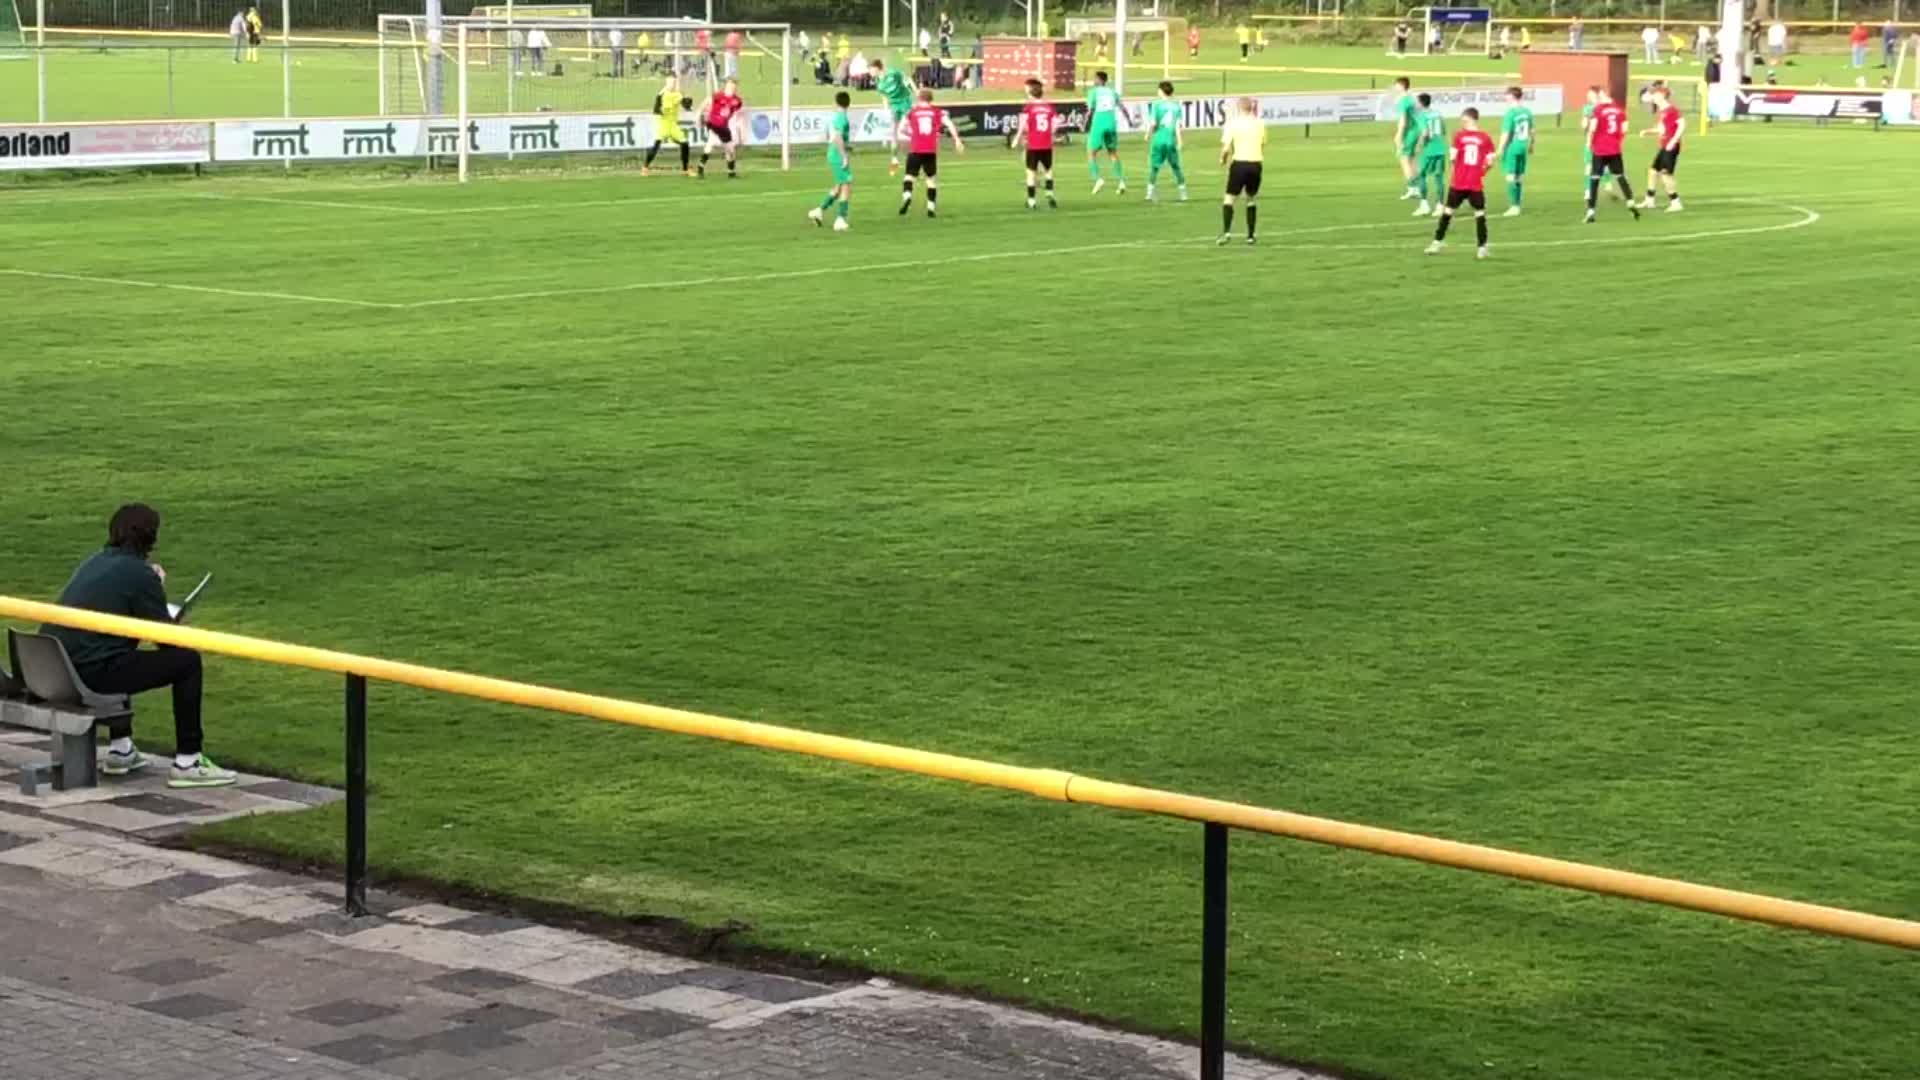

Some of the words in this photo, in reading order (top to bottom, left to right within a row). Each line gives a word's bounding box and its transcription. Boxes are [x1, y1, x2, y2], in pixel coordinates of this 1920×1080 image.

[343, 123, 396, 154] rmt
[428, 121, 480, 151] rmt
[510, 119, 559, 150] rmt
[588, 116, 636, 147] rmt
[771, 115, 821, 131] KÖSE
[253, 124, 310, 156] rmt
[1463, 144, 1479, 165] 10
